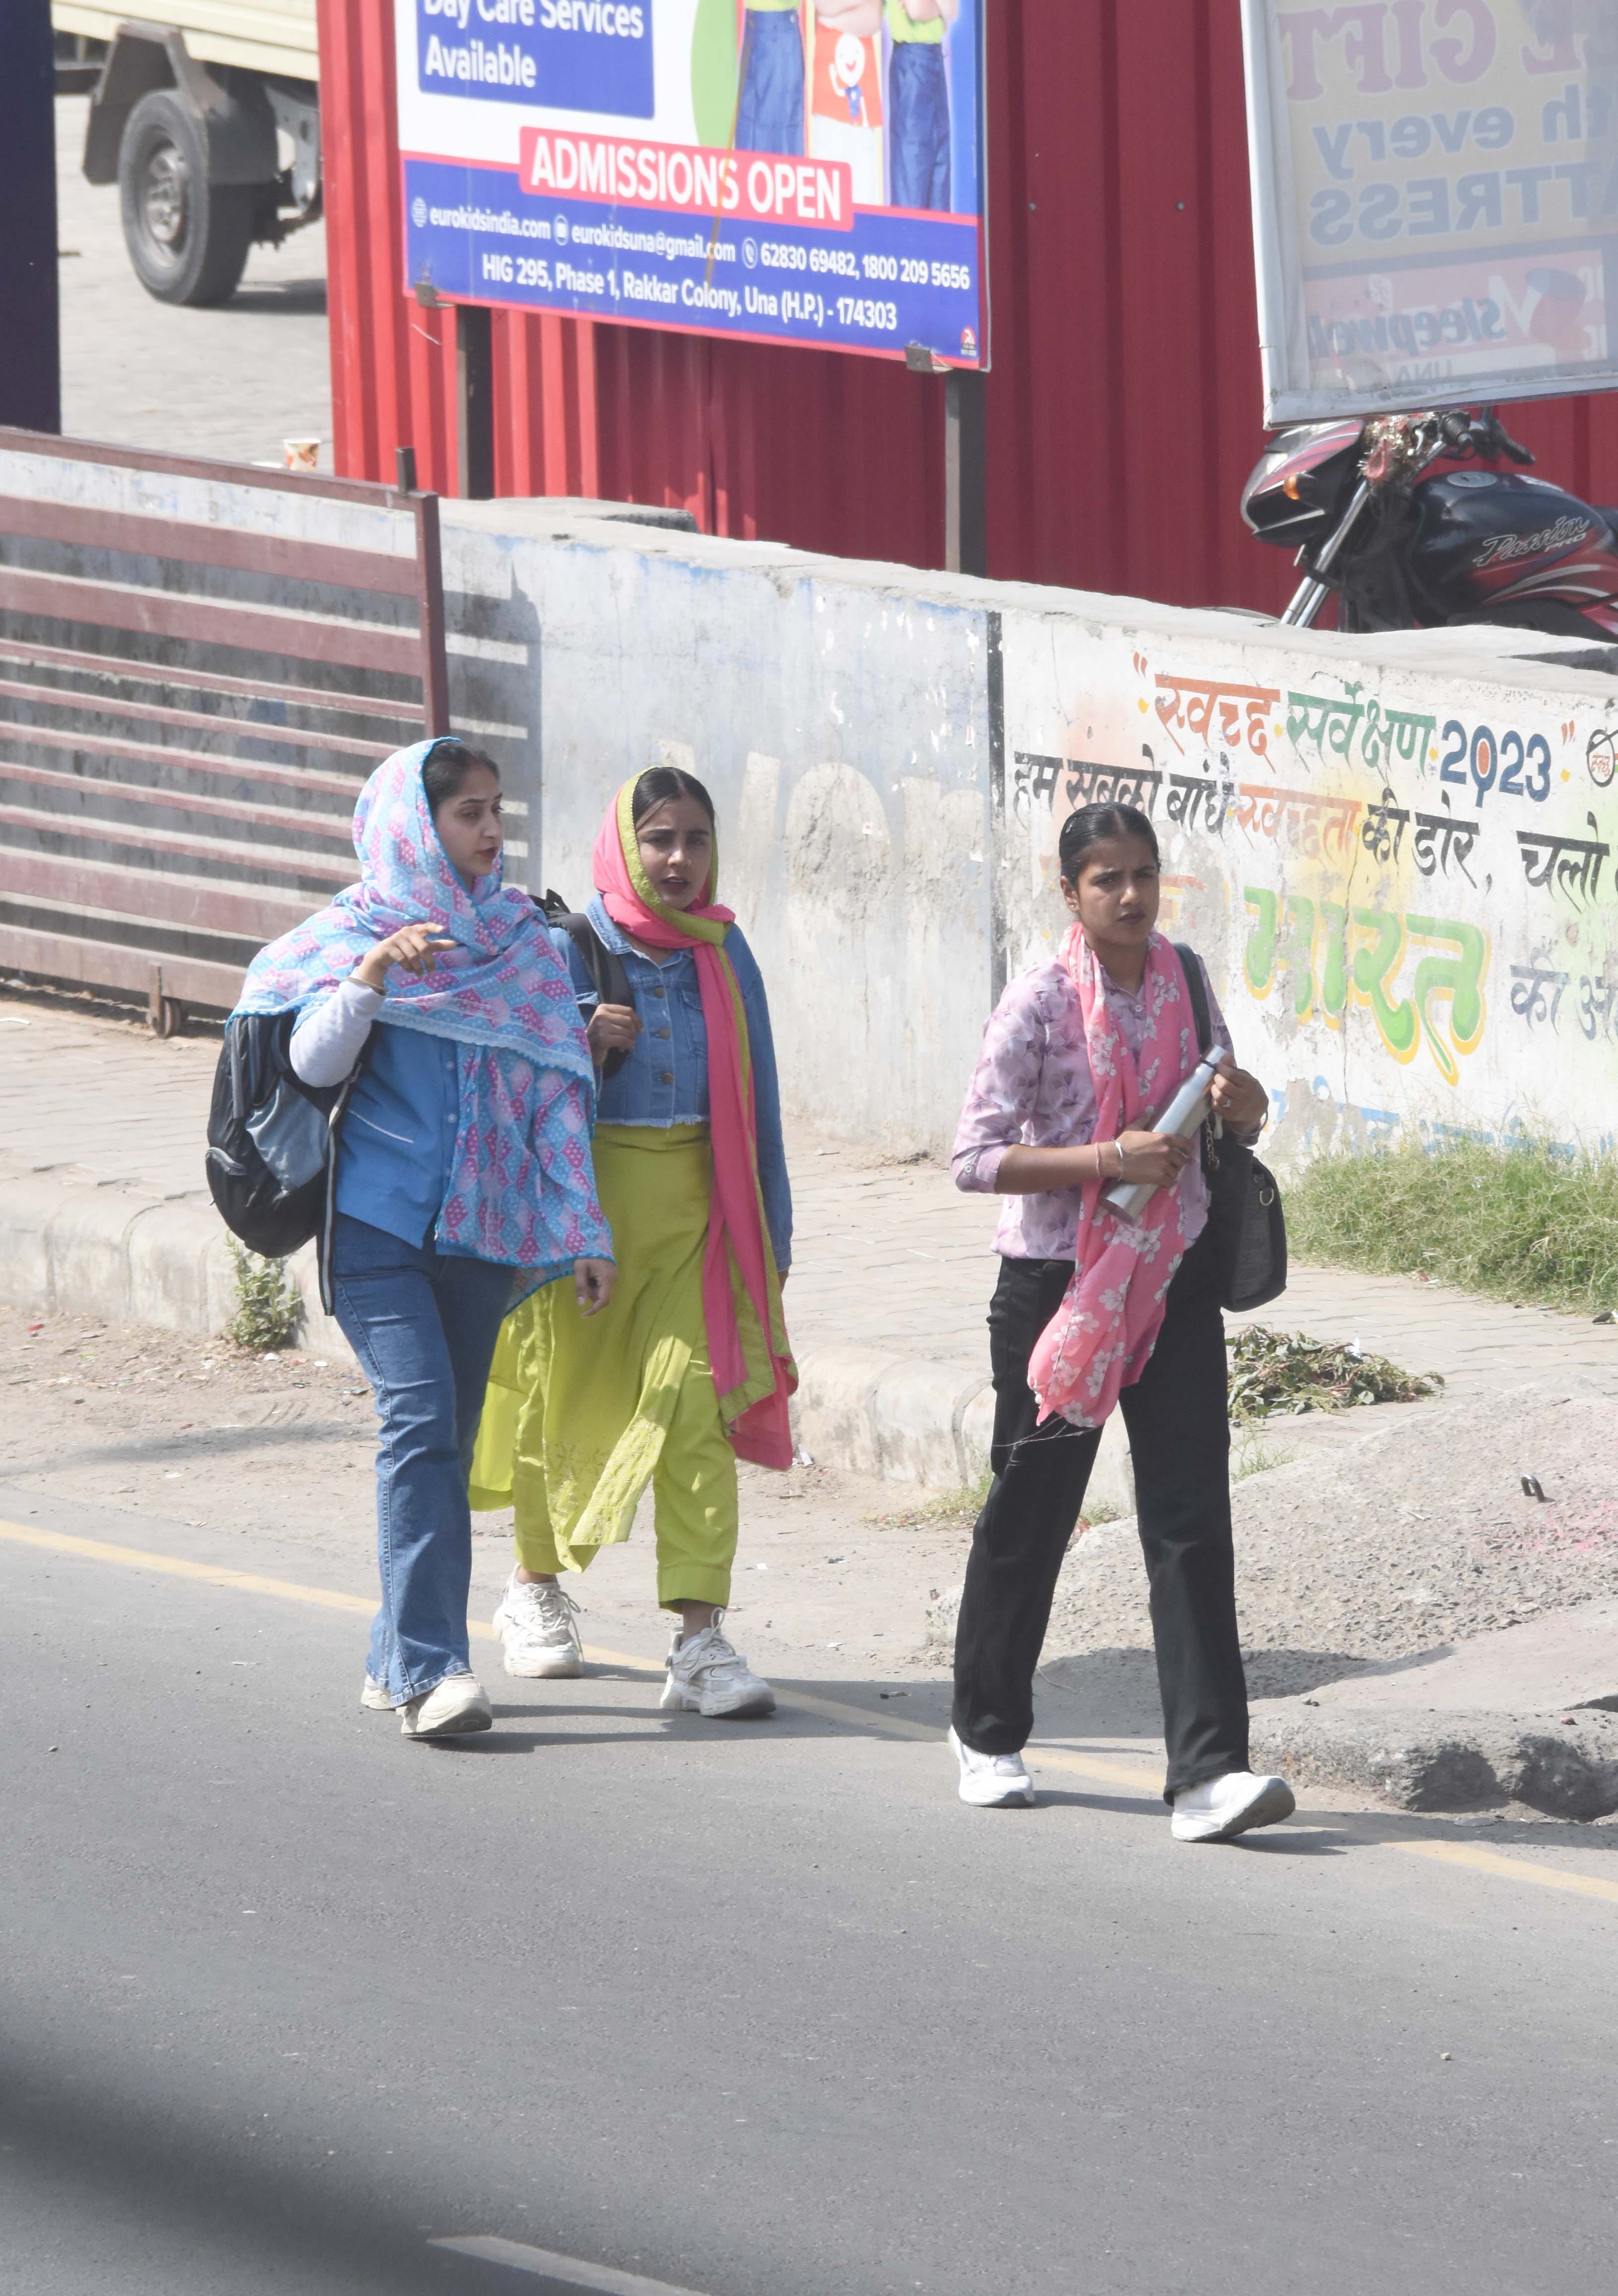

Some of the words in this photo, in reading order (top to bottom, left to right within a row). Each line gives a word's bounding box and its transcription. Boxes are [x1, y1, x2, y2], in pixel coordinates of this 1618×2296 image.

[540, 0, 644, 39] Services
[425, 34, 537, 88] Available
[531, 135, 740, 210] ADMISSIONS
[747, 161, 841, 221] OPEN
[429, 205, 551, 240] eurokidsindia.com
[572, 223, 736, 262] eurokidsuna@gmail.com
[760, 242, 807, 271] 62830
[809, 249, 860, 281] 69482,
[863, 254, 898, 281] 1800
[900, 259, 929, 285] 209
[932, 261, 971, 290] 5656
[482, 253, 514, 283] HIG
[517, 258, 553, 291] 295,
[556, 263, 604, 294] Phase
[607, 270, 620, 300] 1,
[623, 271, 679, 304] Rakkar
[682, 279, 742, 317] Colony,
[745, 286, 778, 316] Una
[781, 290, 824, 328] (H.P.)
[836, 297, 897, 331] 174303
[1472, 516, 1590, 567] Passion
[1013, 750, 1063, 831] हम
[1516, 810, 1611, 914] चलो
